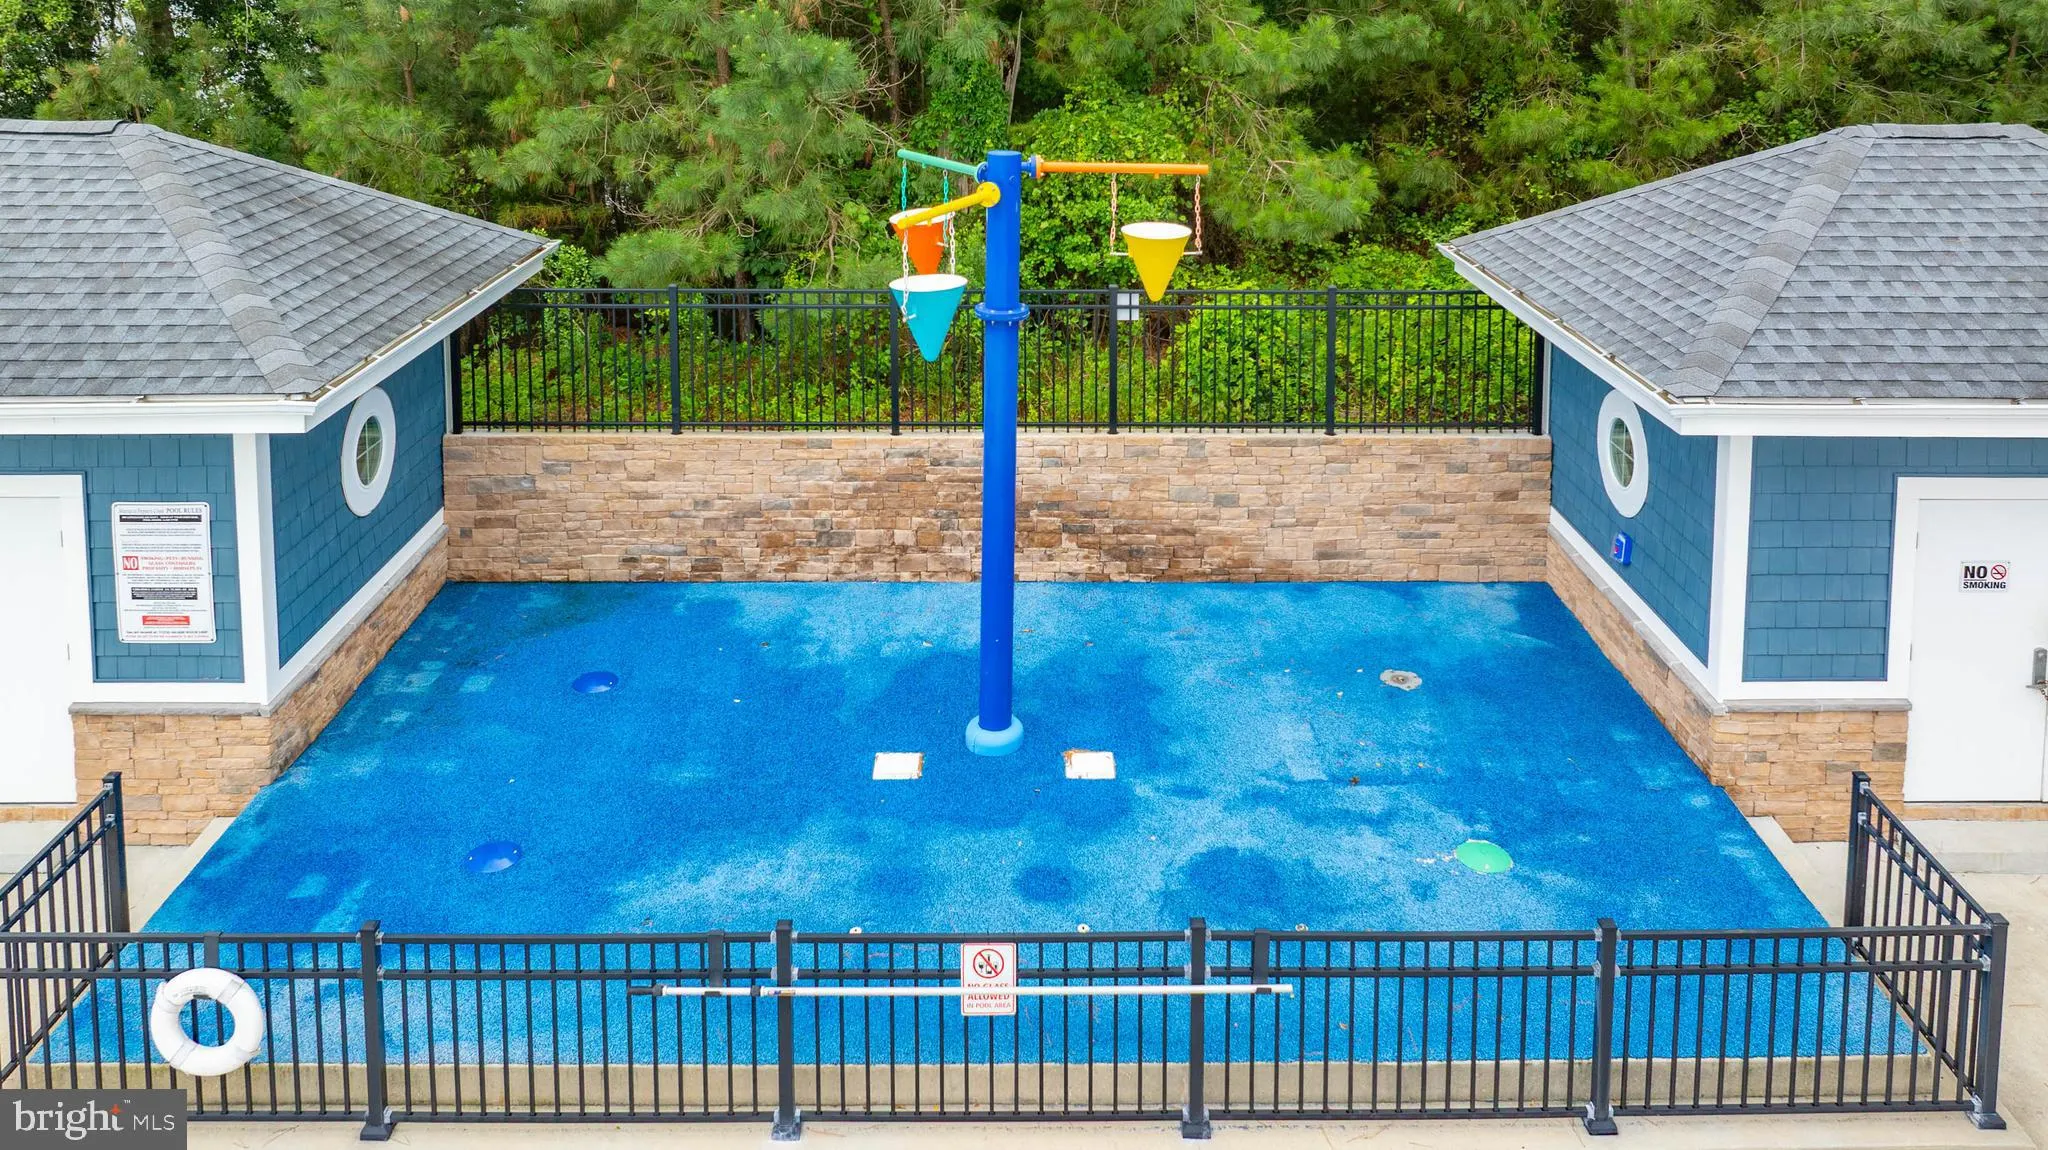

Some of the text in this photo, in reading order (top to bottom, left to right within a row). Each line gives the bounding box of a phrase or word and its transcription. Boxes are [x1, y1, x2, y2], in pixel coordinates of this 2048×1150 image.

[123, 557, 138, 570] NO
[1964, 566, 1988, 579] NO
[1963, 581, 2006, 589] SMOKING
